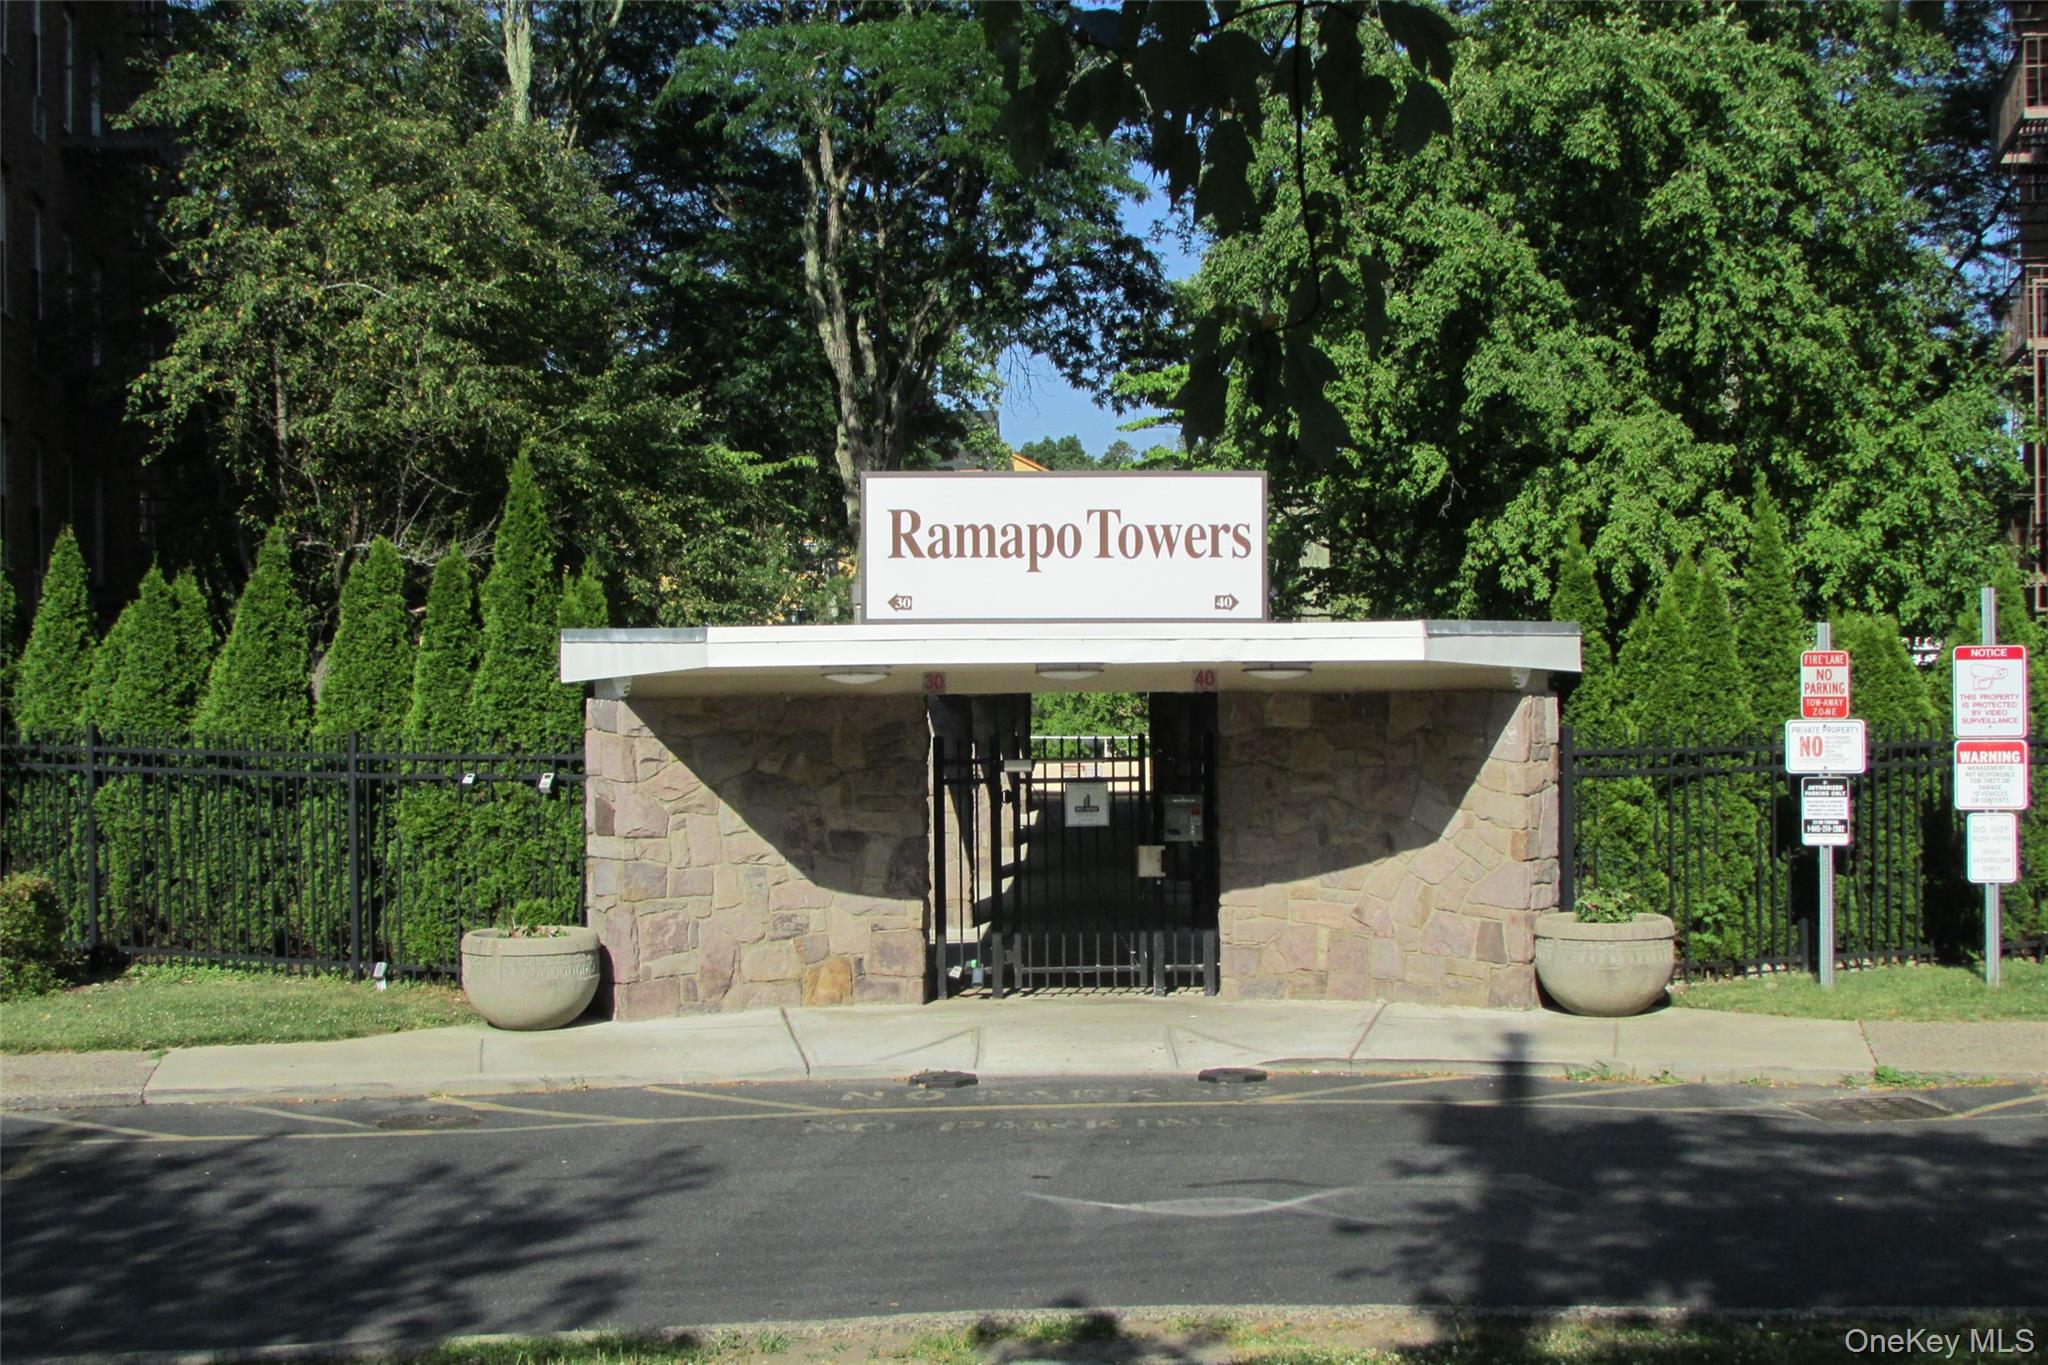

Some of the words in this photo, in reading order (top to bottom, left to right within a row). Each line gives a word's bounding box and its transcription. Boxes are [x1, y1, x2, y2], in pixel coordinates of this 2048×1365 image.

[887, 509, 1082, 573] Ramapo
[1086, 509, 1252, 560] Towers
[894, 597, 911, 609] 30
[1216, 597, 1233, 609] 40
[1804, 655, 1824, 664] FIRE
[1825, 654, 1845, 664] LANE
[1971, 649, 2008, 657] NOTICE
[1195, 670, 1214, 686] 40
[1816, 669, 1832, 680] NO
[925, 673, 944, 690] 30
[1804, 682, 1845, 694] PARKING
[1806, 698, 1843, 706] TOW-AWAY
[1812, 707, 1838, 716] ZONE
[1791, 726, 1821, 734] PRIVATE
[1823, 726, 1860, 734] PROPERTY
[1799, 736, 1823, 757] NO
[1960, 751, 2021, 763] WARNING
